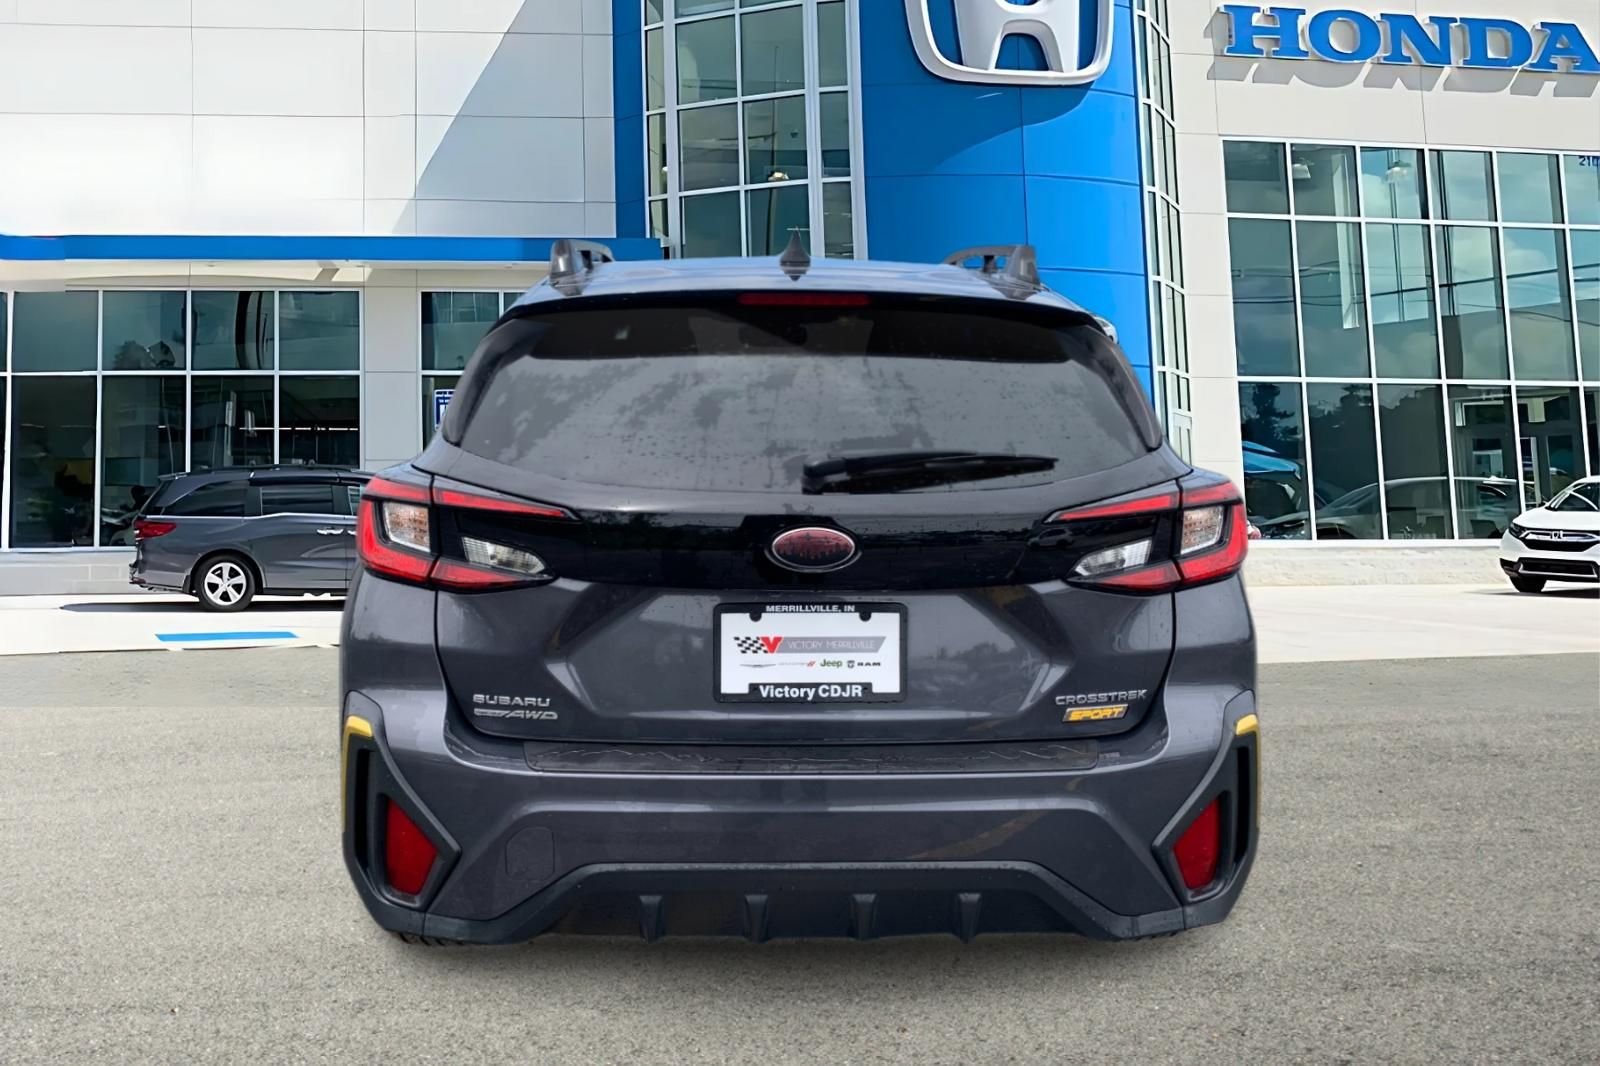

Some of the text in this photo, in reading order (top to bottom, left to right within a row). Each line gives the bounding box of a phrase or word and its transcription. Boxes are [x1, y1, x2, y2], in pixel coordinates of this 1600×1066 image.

[1221, 5, 1600, 73] HONDA
[765, 605, 842, 613] MERRILLVILLE,
[788, 640, 823, 649] VICTORY
[820, 659, 843, 668] Jeep
[759, 685, 863, 700] Victory CDJR
[1055, 689, 1148, 705] CROSSTREK
[473, 694, 550, 707] SUBARU
[505, 710, 558, 720] AWD
[1068, 707, 1125, 720] SPORT
